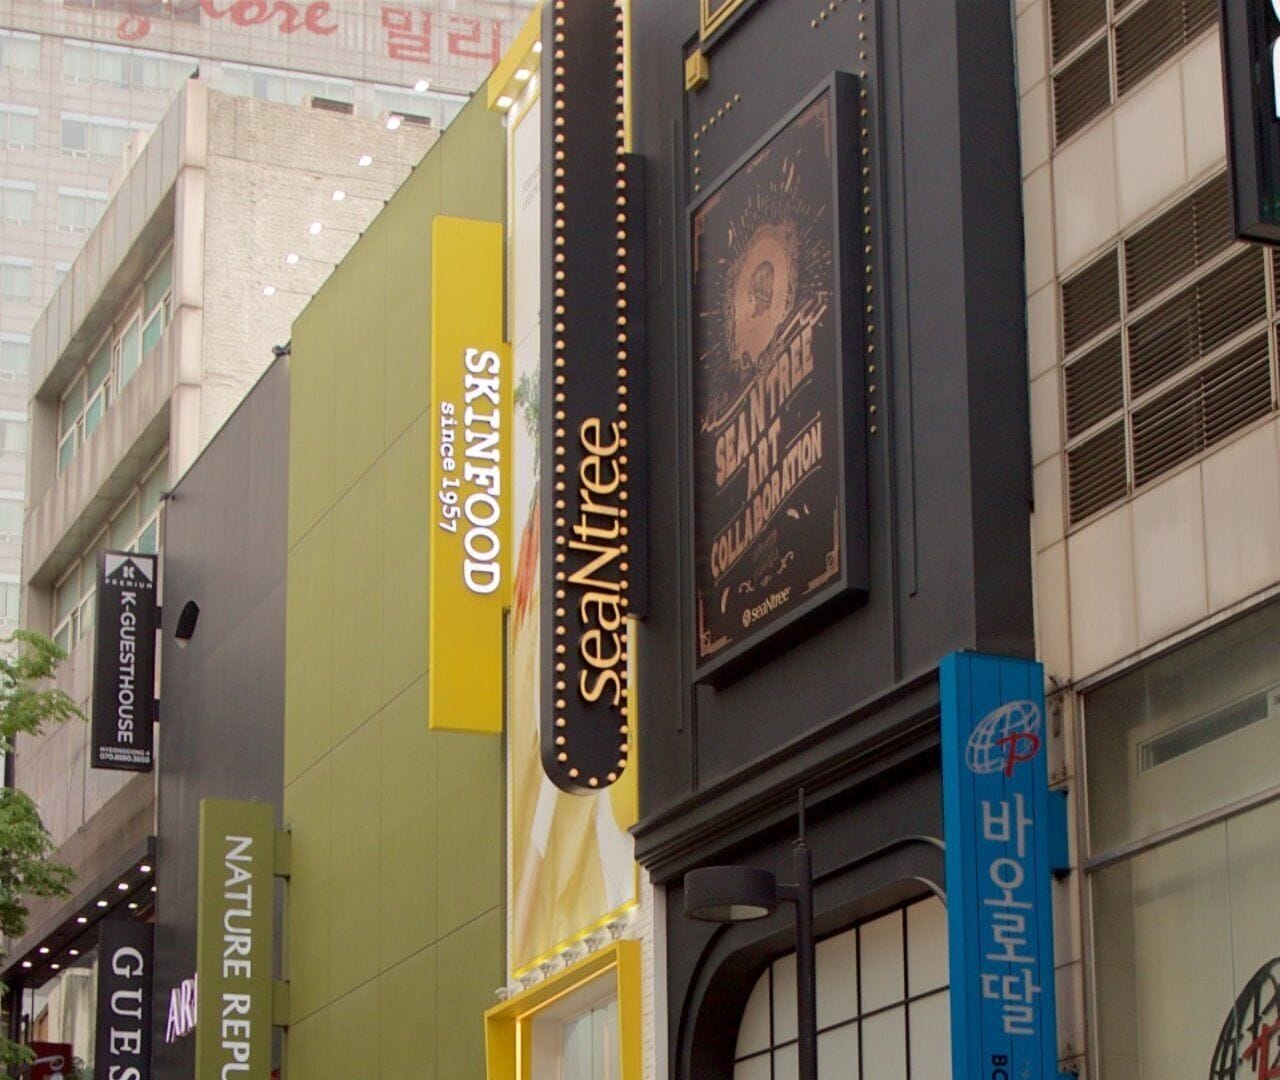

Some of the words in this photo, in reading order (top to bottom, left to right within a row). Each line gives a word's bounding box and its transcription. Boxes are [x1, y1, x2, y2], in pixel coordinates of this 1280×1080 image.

[441, 402, 456, 471] since
[442, 478, 461, 534] 1957
[463, 346, 502, 596] SKINFOOD
[711, 420, 823, 580] COLLABORATION
[747, 416, 782, 501] ART
[567, 416, 621, 706] seaNtree
[117, 591, 137, 744] K-GUESTHOUSE
[223, 836, 253, 980] NATURE
[980, 793, 1043, 1036] 바오로딸
[166, 972, 198, 1043] ARI
